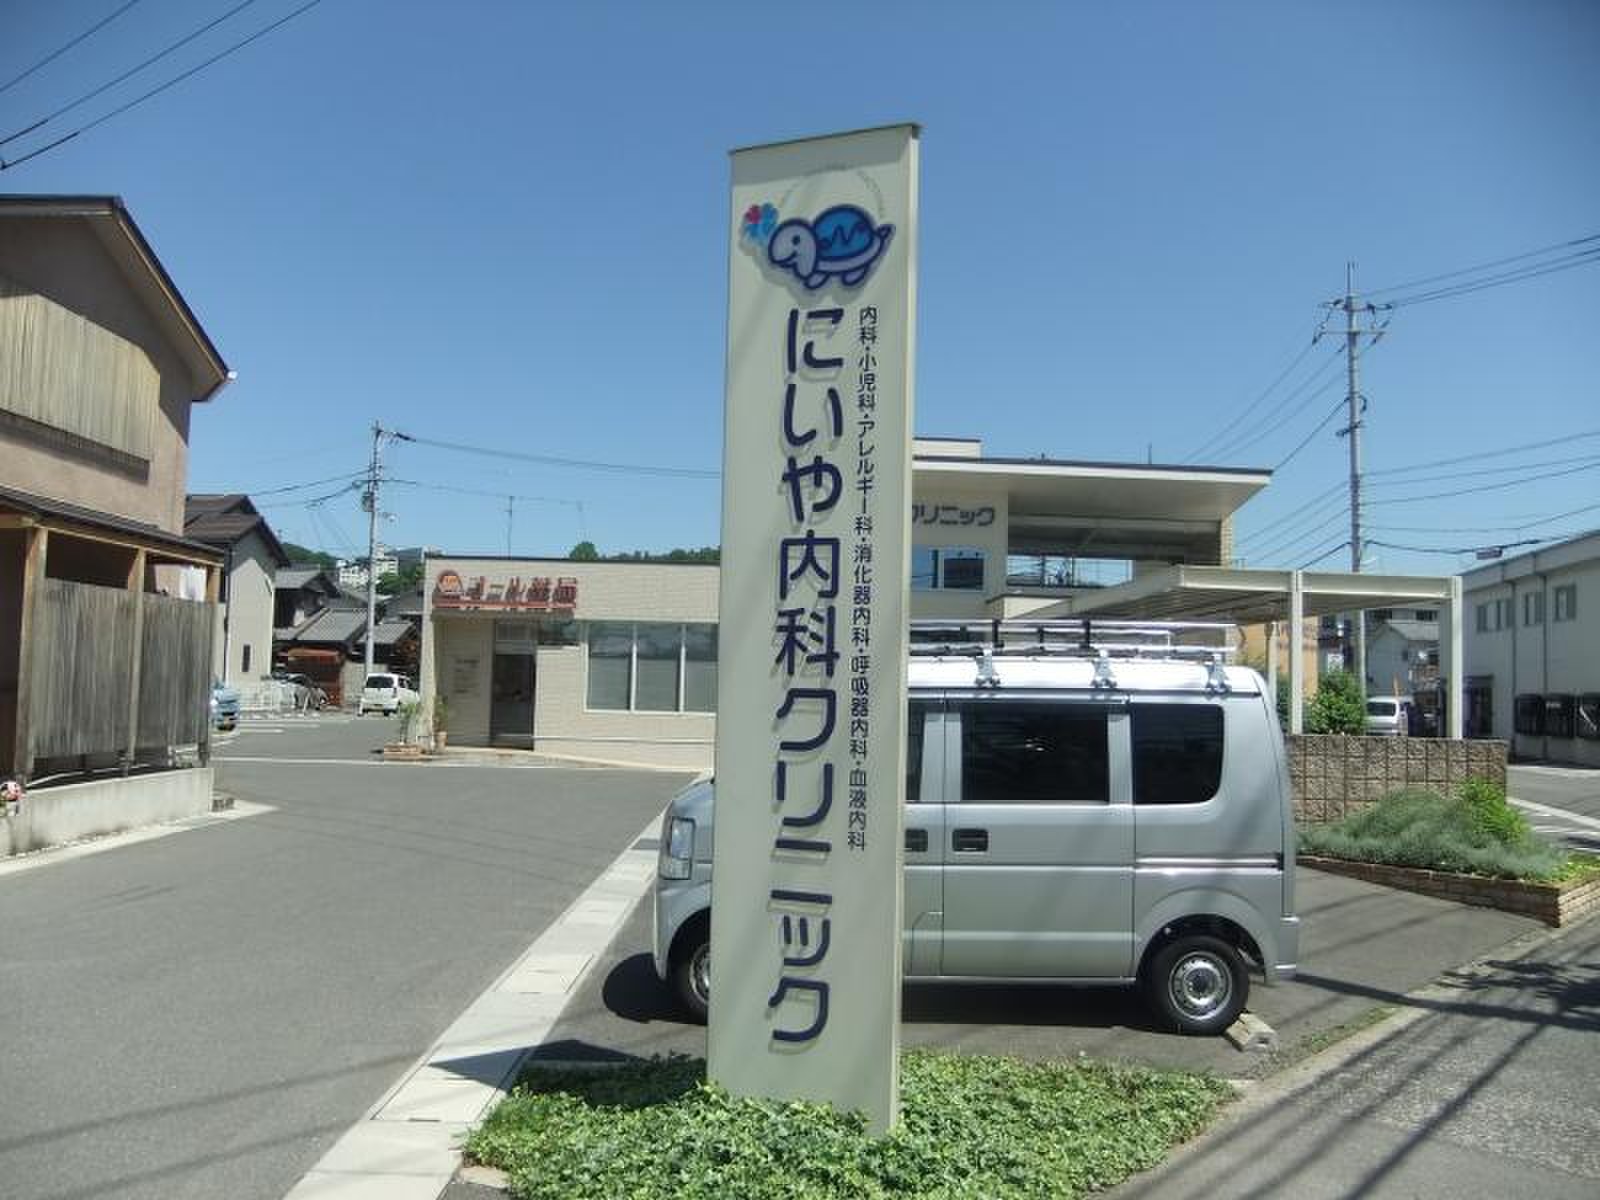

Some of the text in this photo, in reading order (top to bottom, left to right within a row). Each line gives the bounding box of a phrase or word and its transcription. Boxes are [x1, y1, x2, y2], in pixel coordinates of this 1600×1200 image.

[768, 308, 844, 1043] にいや内科クリニック
